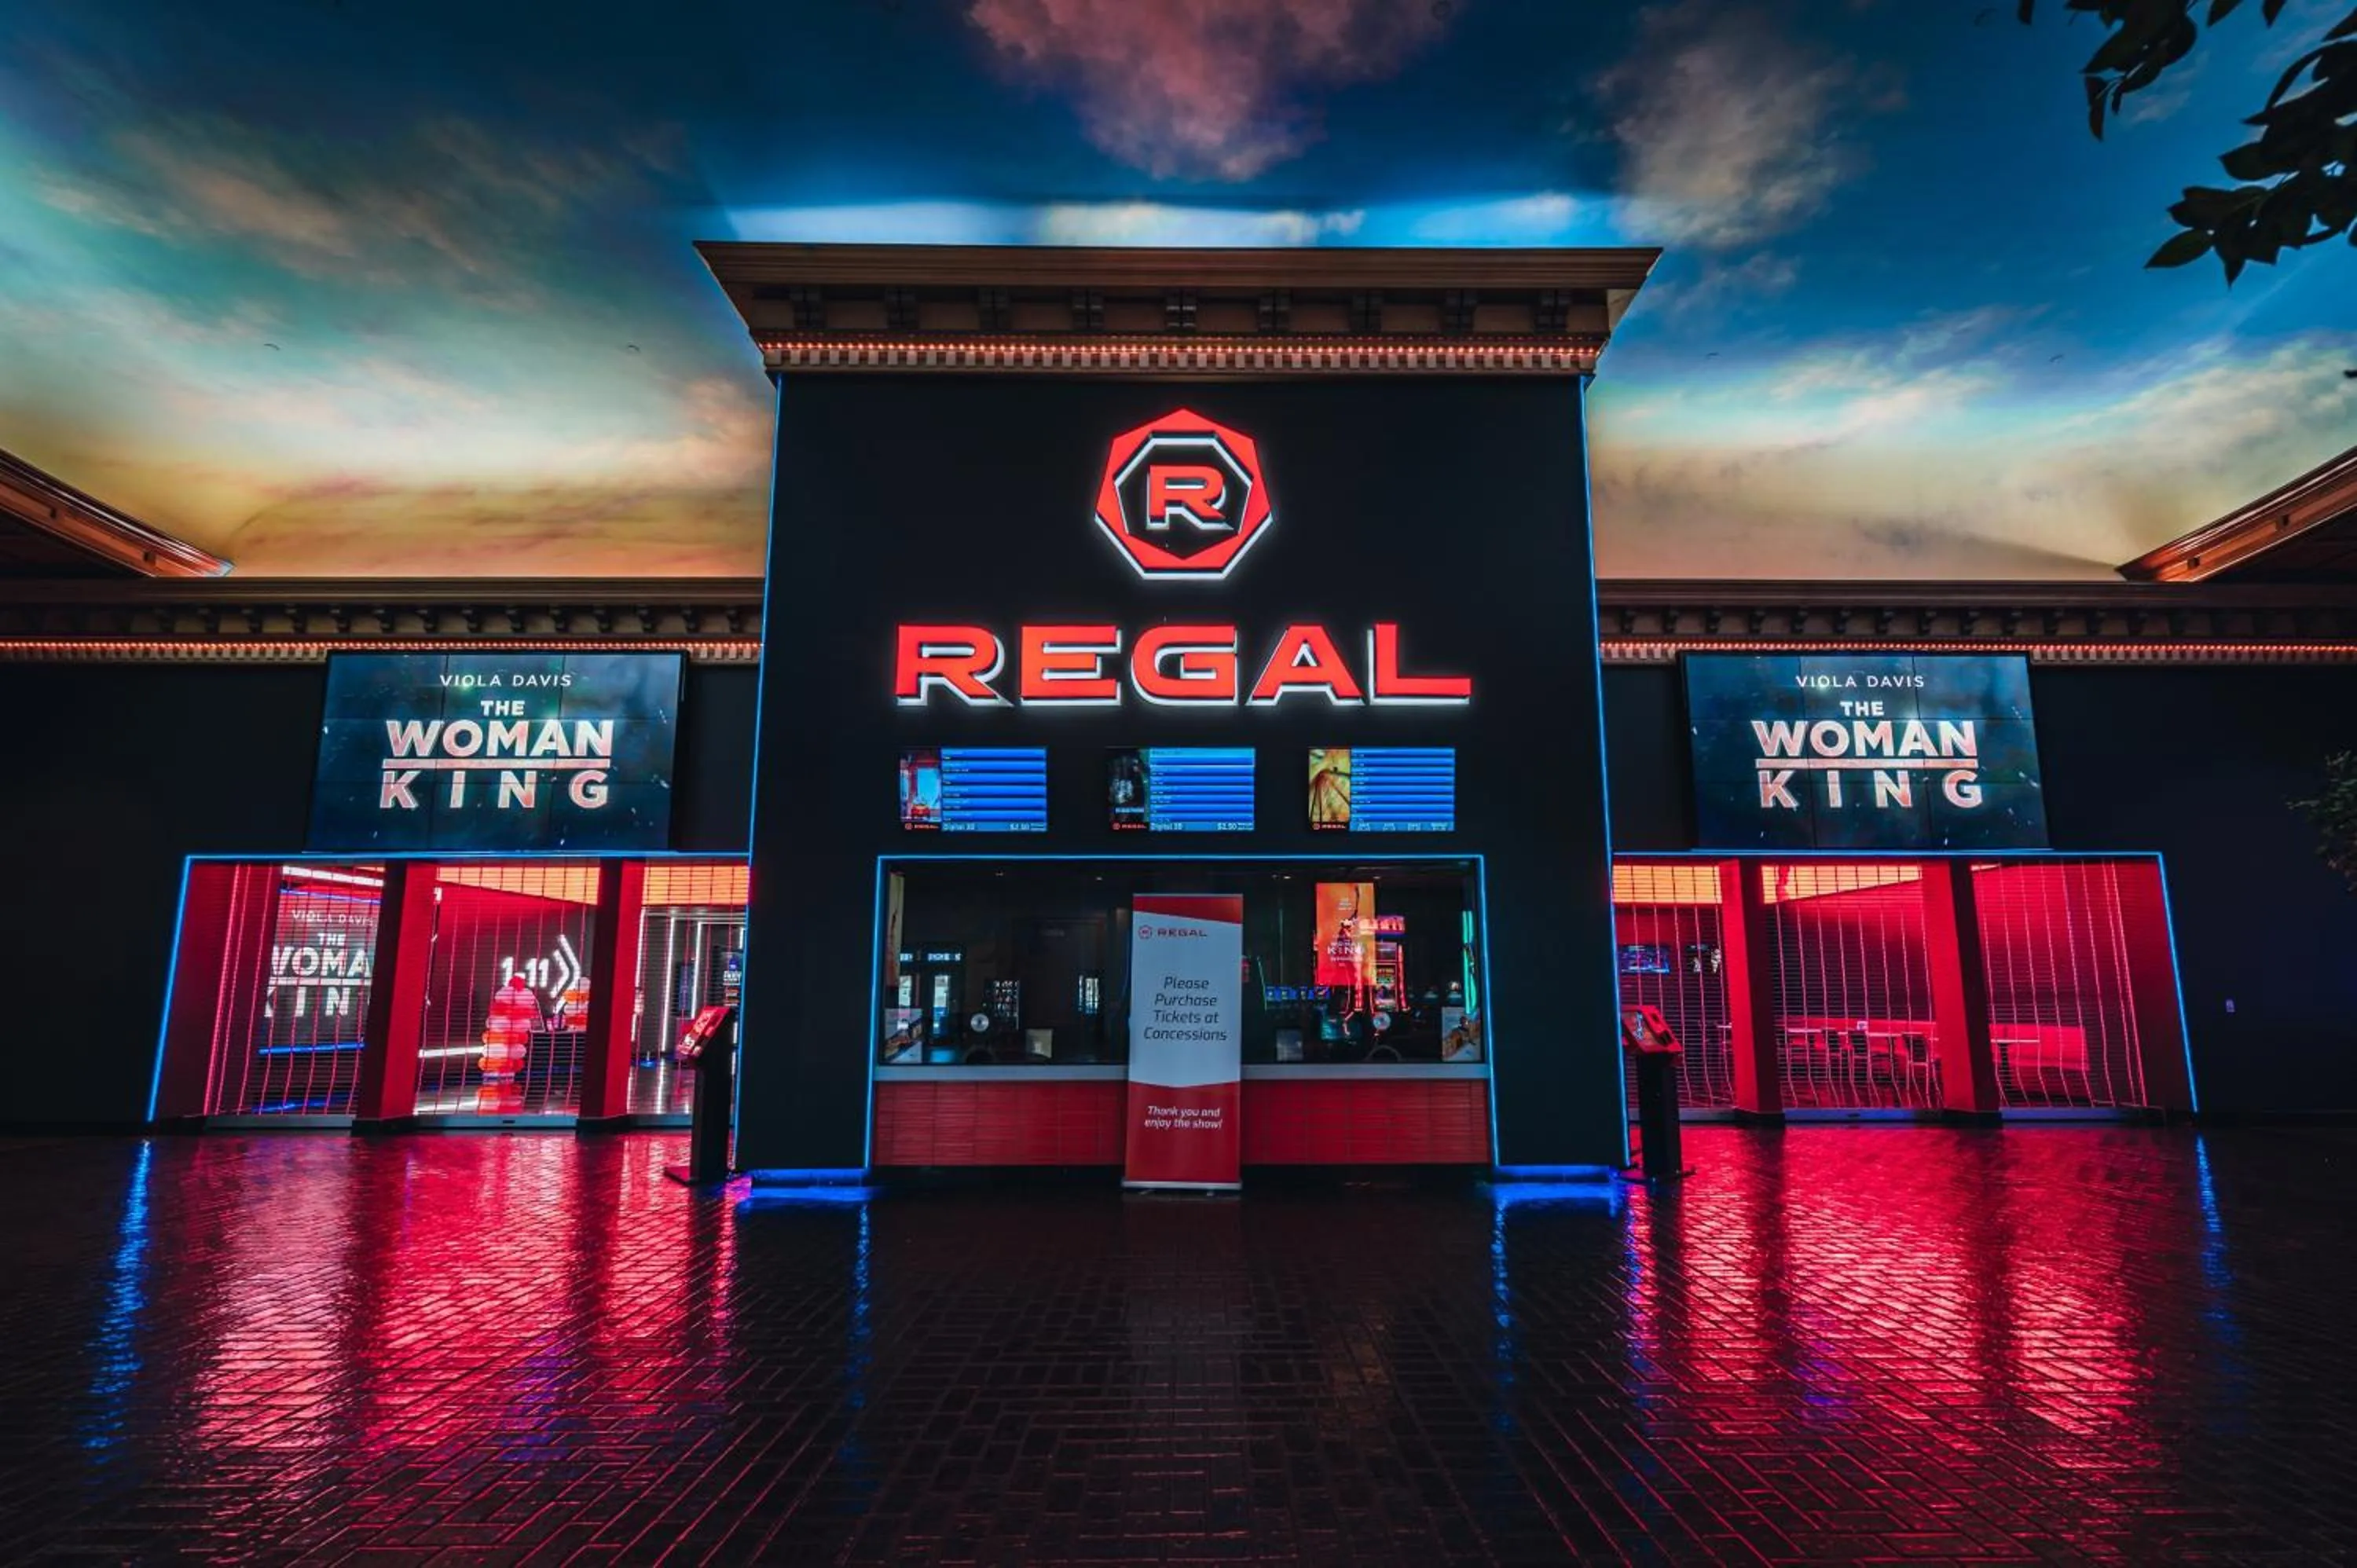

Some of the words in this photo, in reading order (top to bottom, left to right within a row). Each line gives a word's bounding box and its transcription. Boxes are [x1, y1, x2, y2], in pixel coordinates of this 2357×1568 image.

[1147, 465, 1233, 529] R
[895, 624, 1472, 706] REGAL
[440, 675, 501, 687] VIOLA
[512, 675, 573, 687] DAVIS
[1796, 676, 1857, 687] VIOLA
[1868, 676, 1925, 687] DAVIS
[480, 700, 526, 716] THE
[1839, 701, 1885, 716] THE
[386, 720, 614, 757] WOMAN
[1751, 720, 1978, 757] WOMAN
[379, 769, 610, 809] KING
[1757, 769, 1983, 809] KING
[317, 933, 346, 946] THE
[1157, 928, 1208, 937] REGAL
[1164, 976, 1209, 990] Please
[1154, 993, 1217, 1006] Purchase
[1154, 1009, 1201, 1024] Tickets
[1204, 1012, 1219, 1024] at
[1144, 1027, 1227, 1042] Concessions
[1147, 1105, 1178, 1116] Thank
[1180, 1108, 1199, 1118] you
[1201, 1108, 1220, 1117] and
[1144, 1119, 1171, 1130] enjoy
[1174, 1119, 1190, 1128] the
[1193, 1119, 1223, 1129] show!
